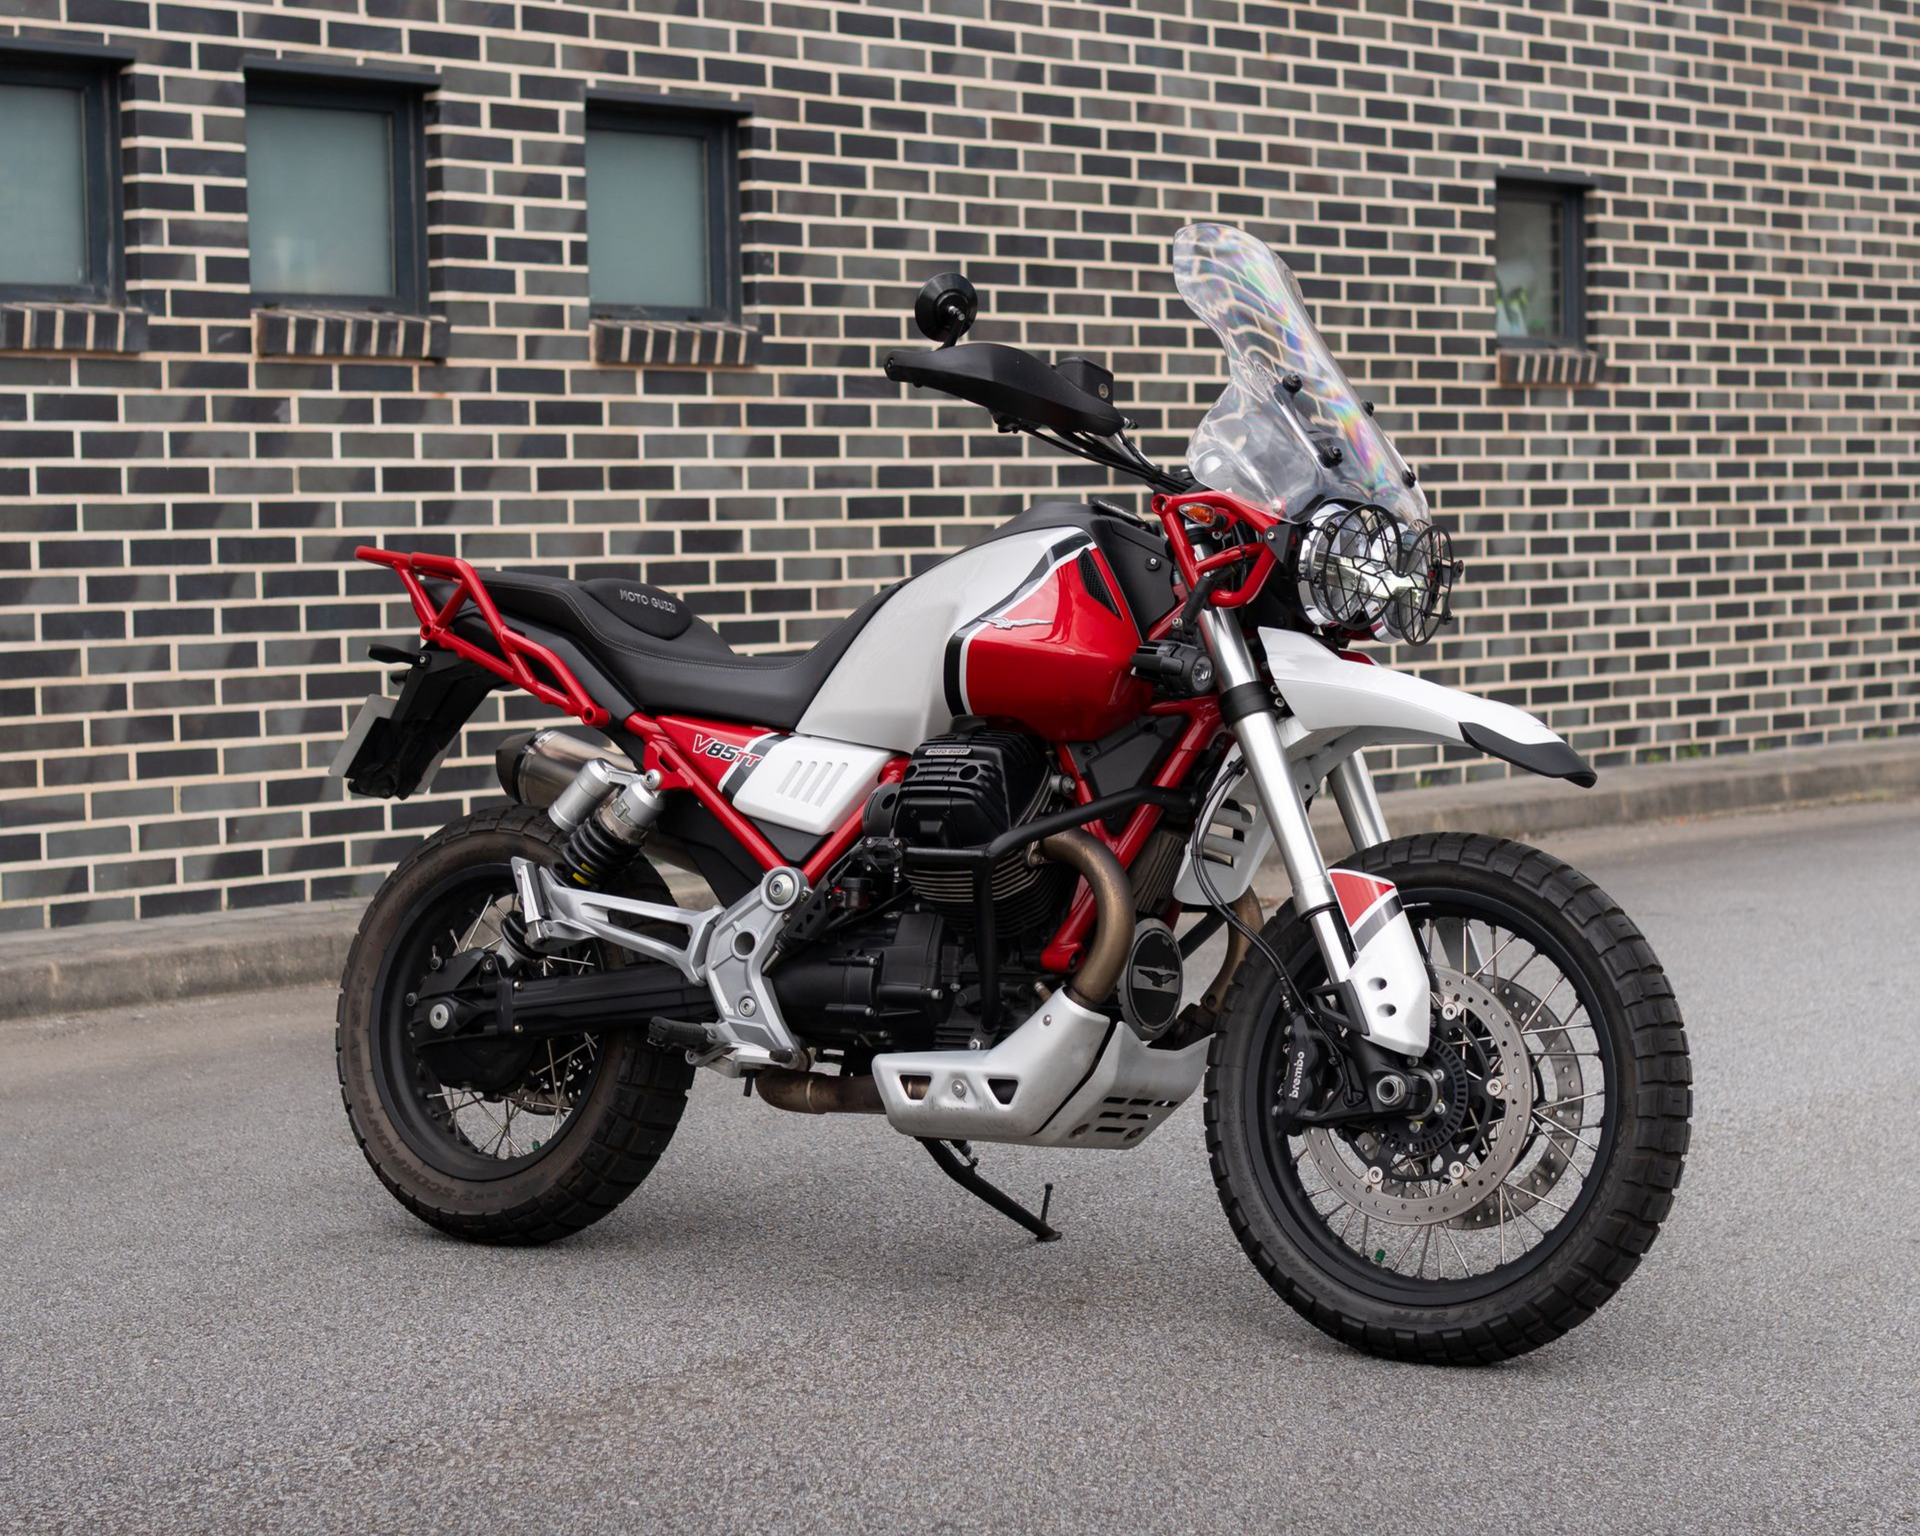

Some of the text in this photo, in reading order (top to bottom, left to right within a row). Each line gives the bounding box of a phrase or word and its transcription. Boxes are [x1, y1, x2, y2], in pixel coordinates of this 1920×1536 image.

[619, 589, 677, 614] MOTO GUZZI
[692, 734, 763, 767] V85TT
[1288, 1051, 1305, 1099] brembo
